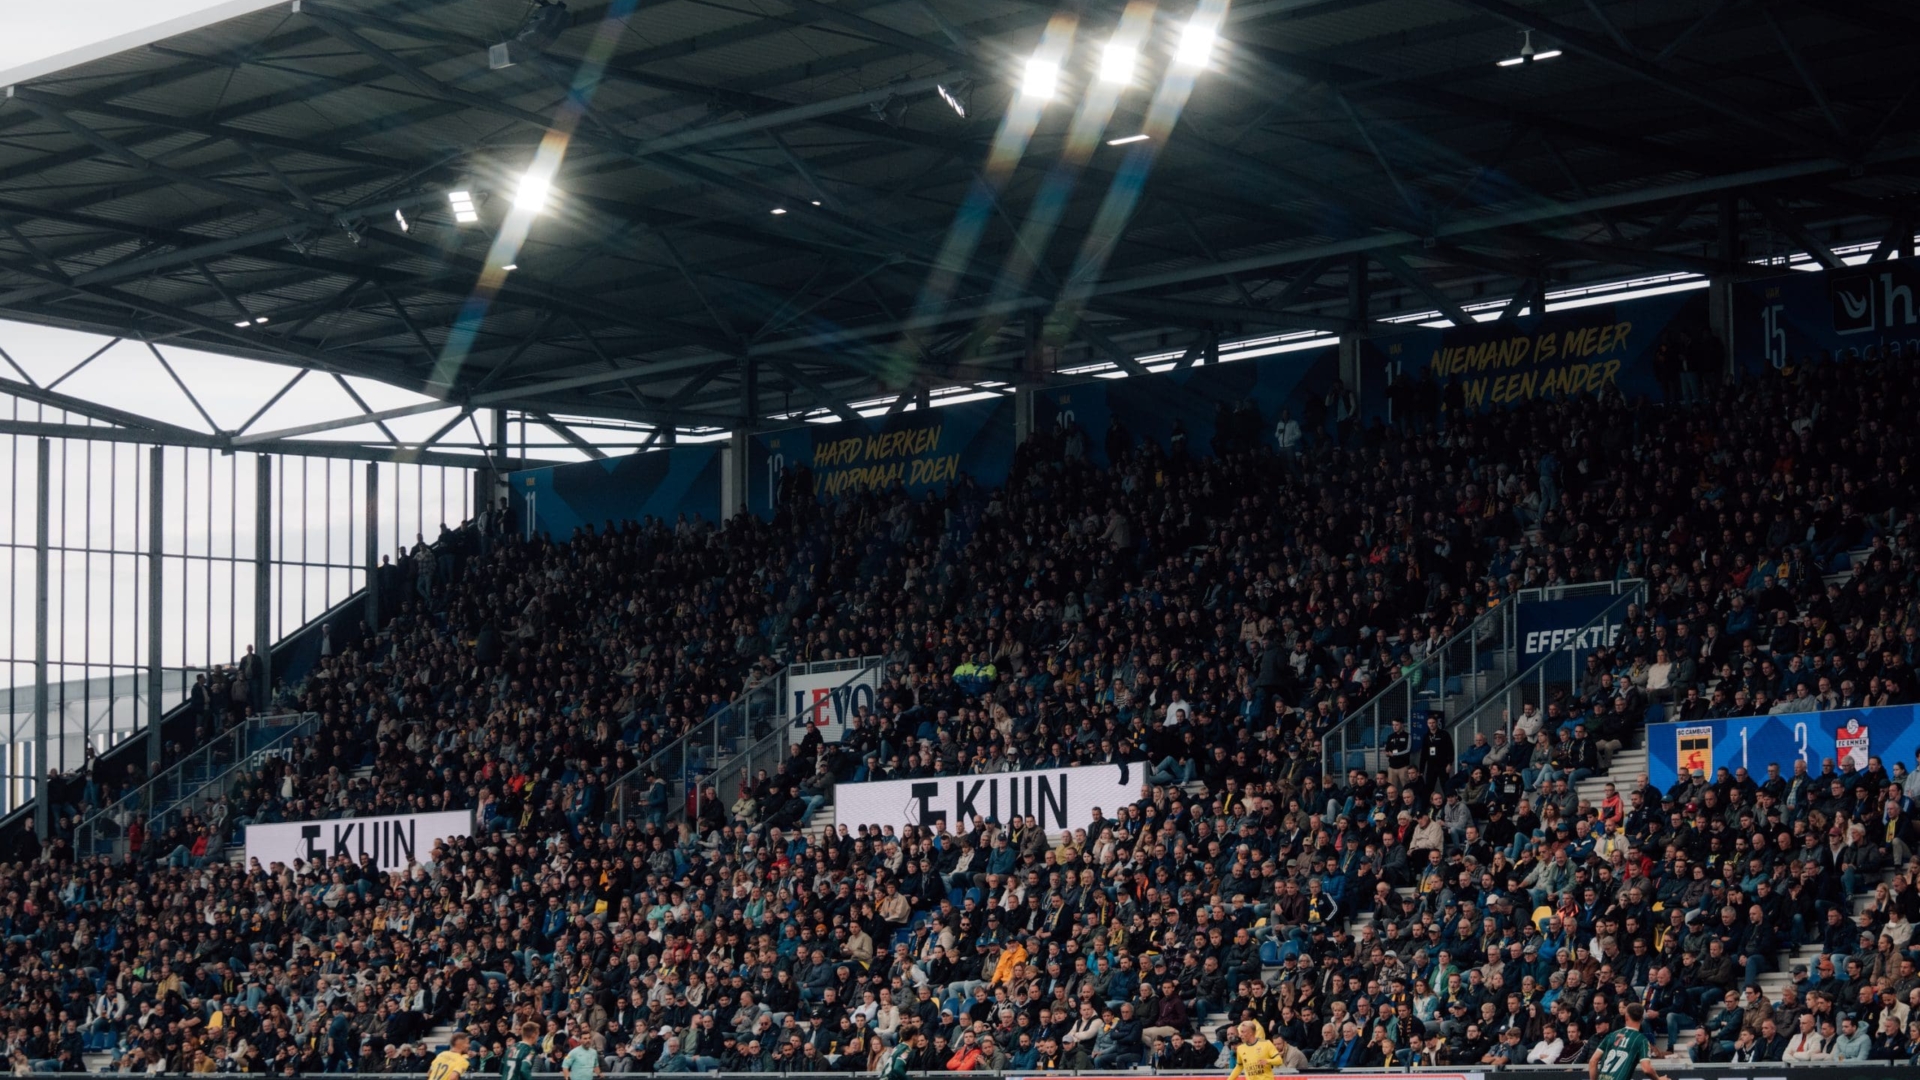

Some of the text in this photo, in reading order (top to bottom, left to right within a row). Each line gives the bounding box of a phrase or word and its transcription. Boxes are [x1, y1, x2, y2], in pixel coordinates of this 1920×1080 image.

[1880, 272, 1920, 327] h
[1430, 321, 1632, 377] NIEMAND IS MEER
[1760, 303, 1787, 370] 15
[1490, 367, 1538, 404] EEN
[1540, 359, 1622, 397] ANDER
[813, 424, 942, 469] HARD WERKEN
[909, 453, 960, 486] DOEN
[525, 491, 537, 544] 11
[1525, 622, 1627, 654] EFFEKTIE
[794, 684, 874, 729] LEVO
[1740, 722, 1809, 772] 1 3
[956, 773, 1068, 831] KUIN
[335, 819, 416, 869] KUIN
[1601, 1048, 1629, 1073] 27
